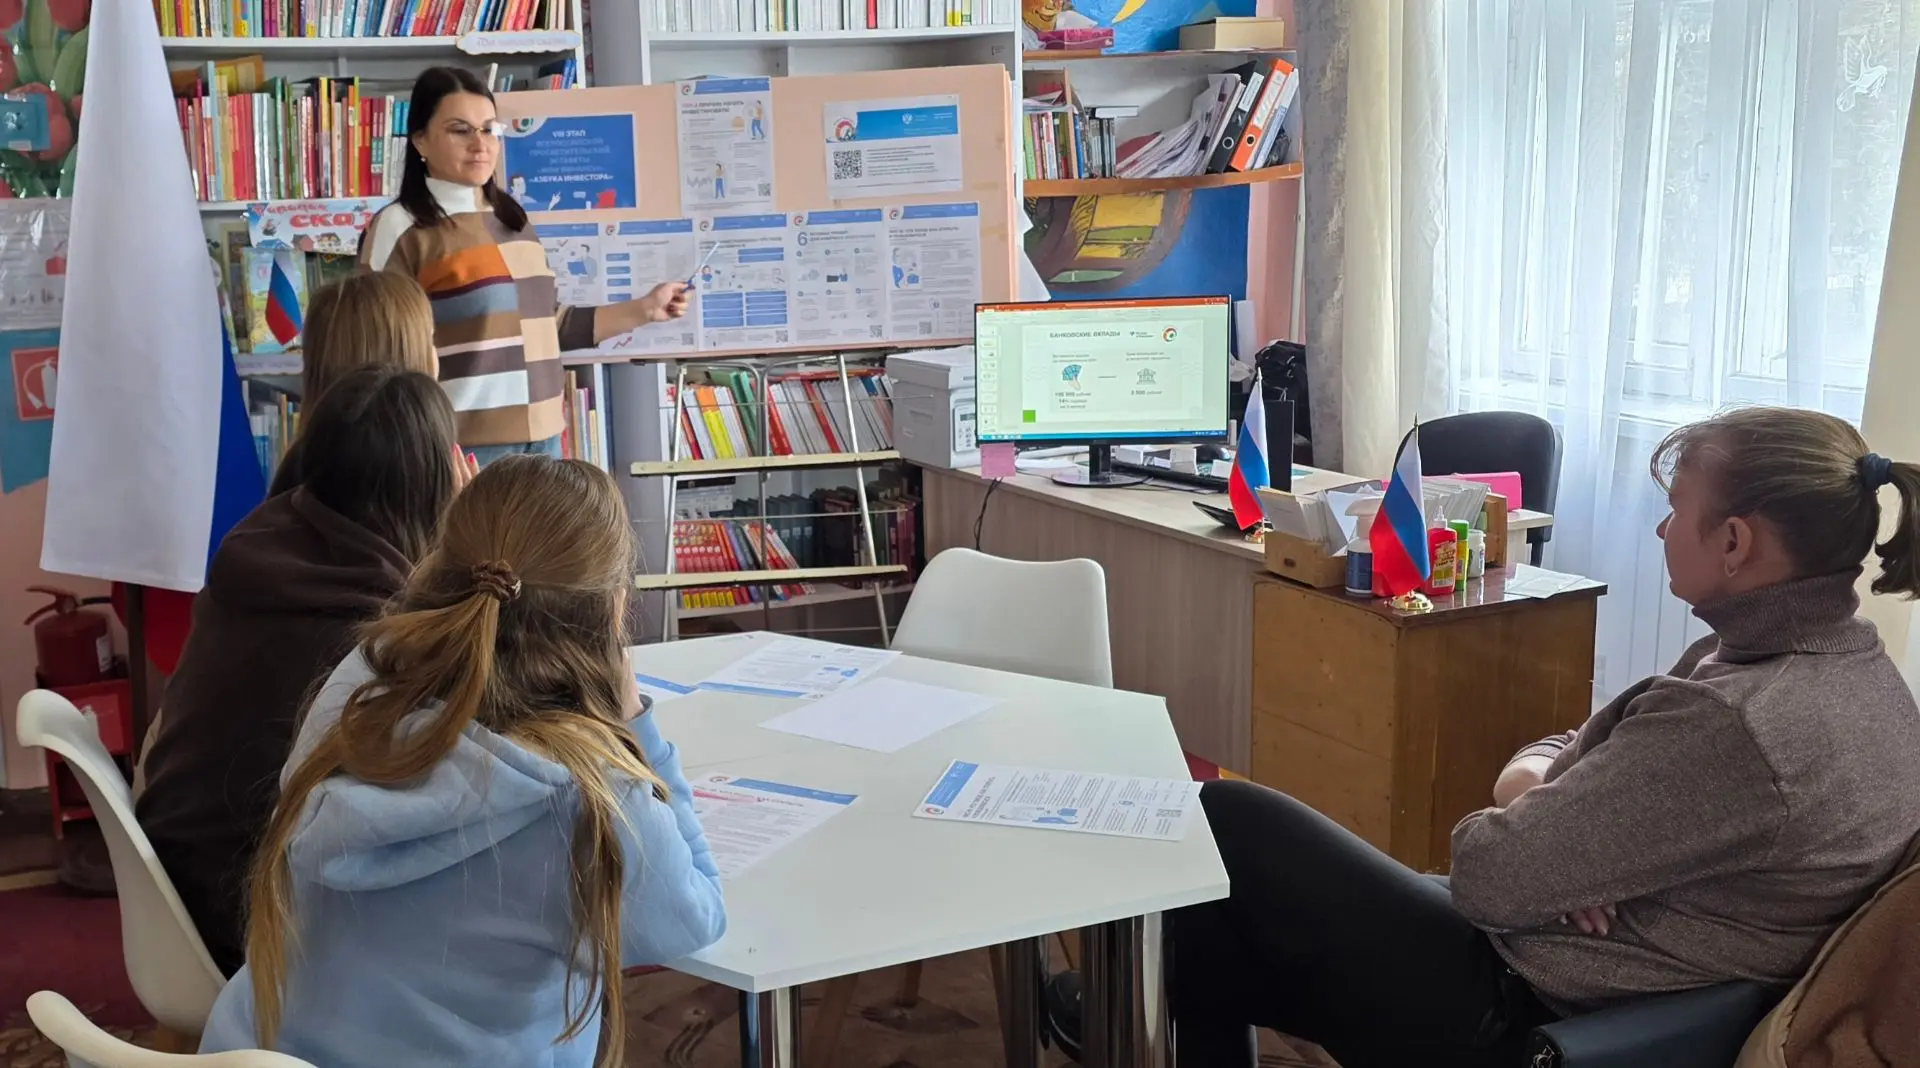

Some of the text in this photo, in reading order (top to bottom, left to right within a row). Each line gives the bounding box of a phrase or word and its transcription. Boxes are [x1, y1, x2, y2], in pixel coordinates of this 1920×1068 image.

[566, 129, 586, 137] ЭТАП
[797, 231, 808, 246] 6
[1050, 330, 1121, 339] БАНКОВСКИЕ ВКЛАДЫ
